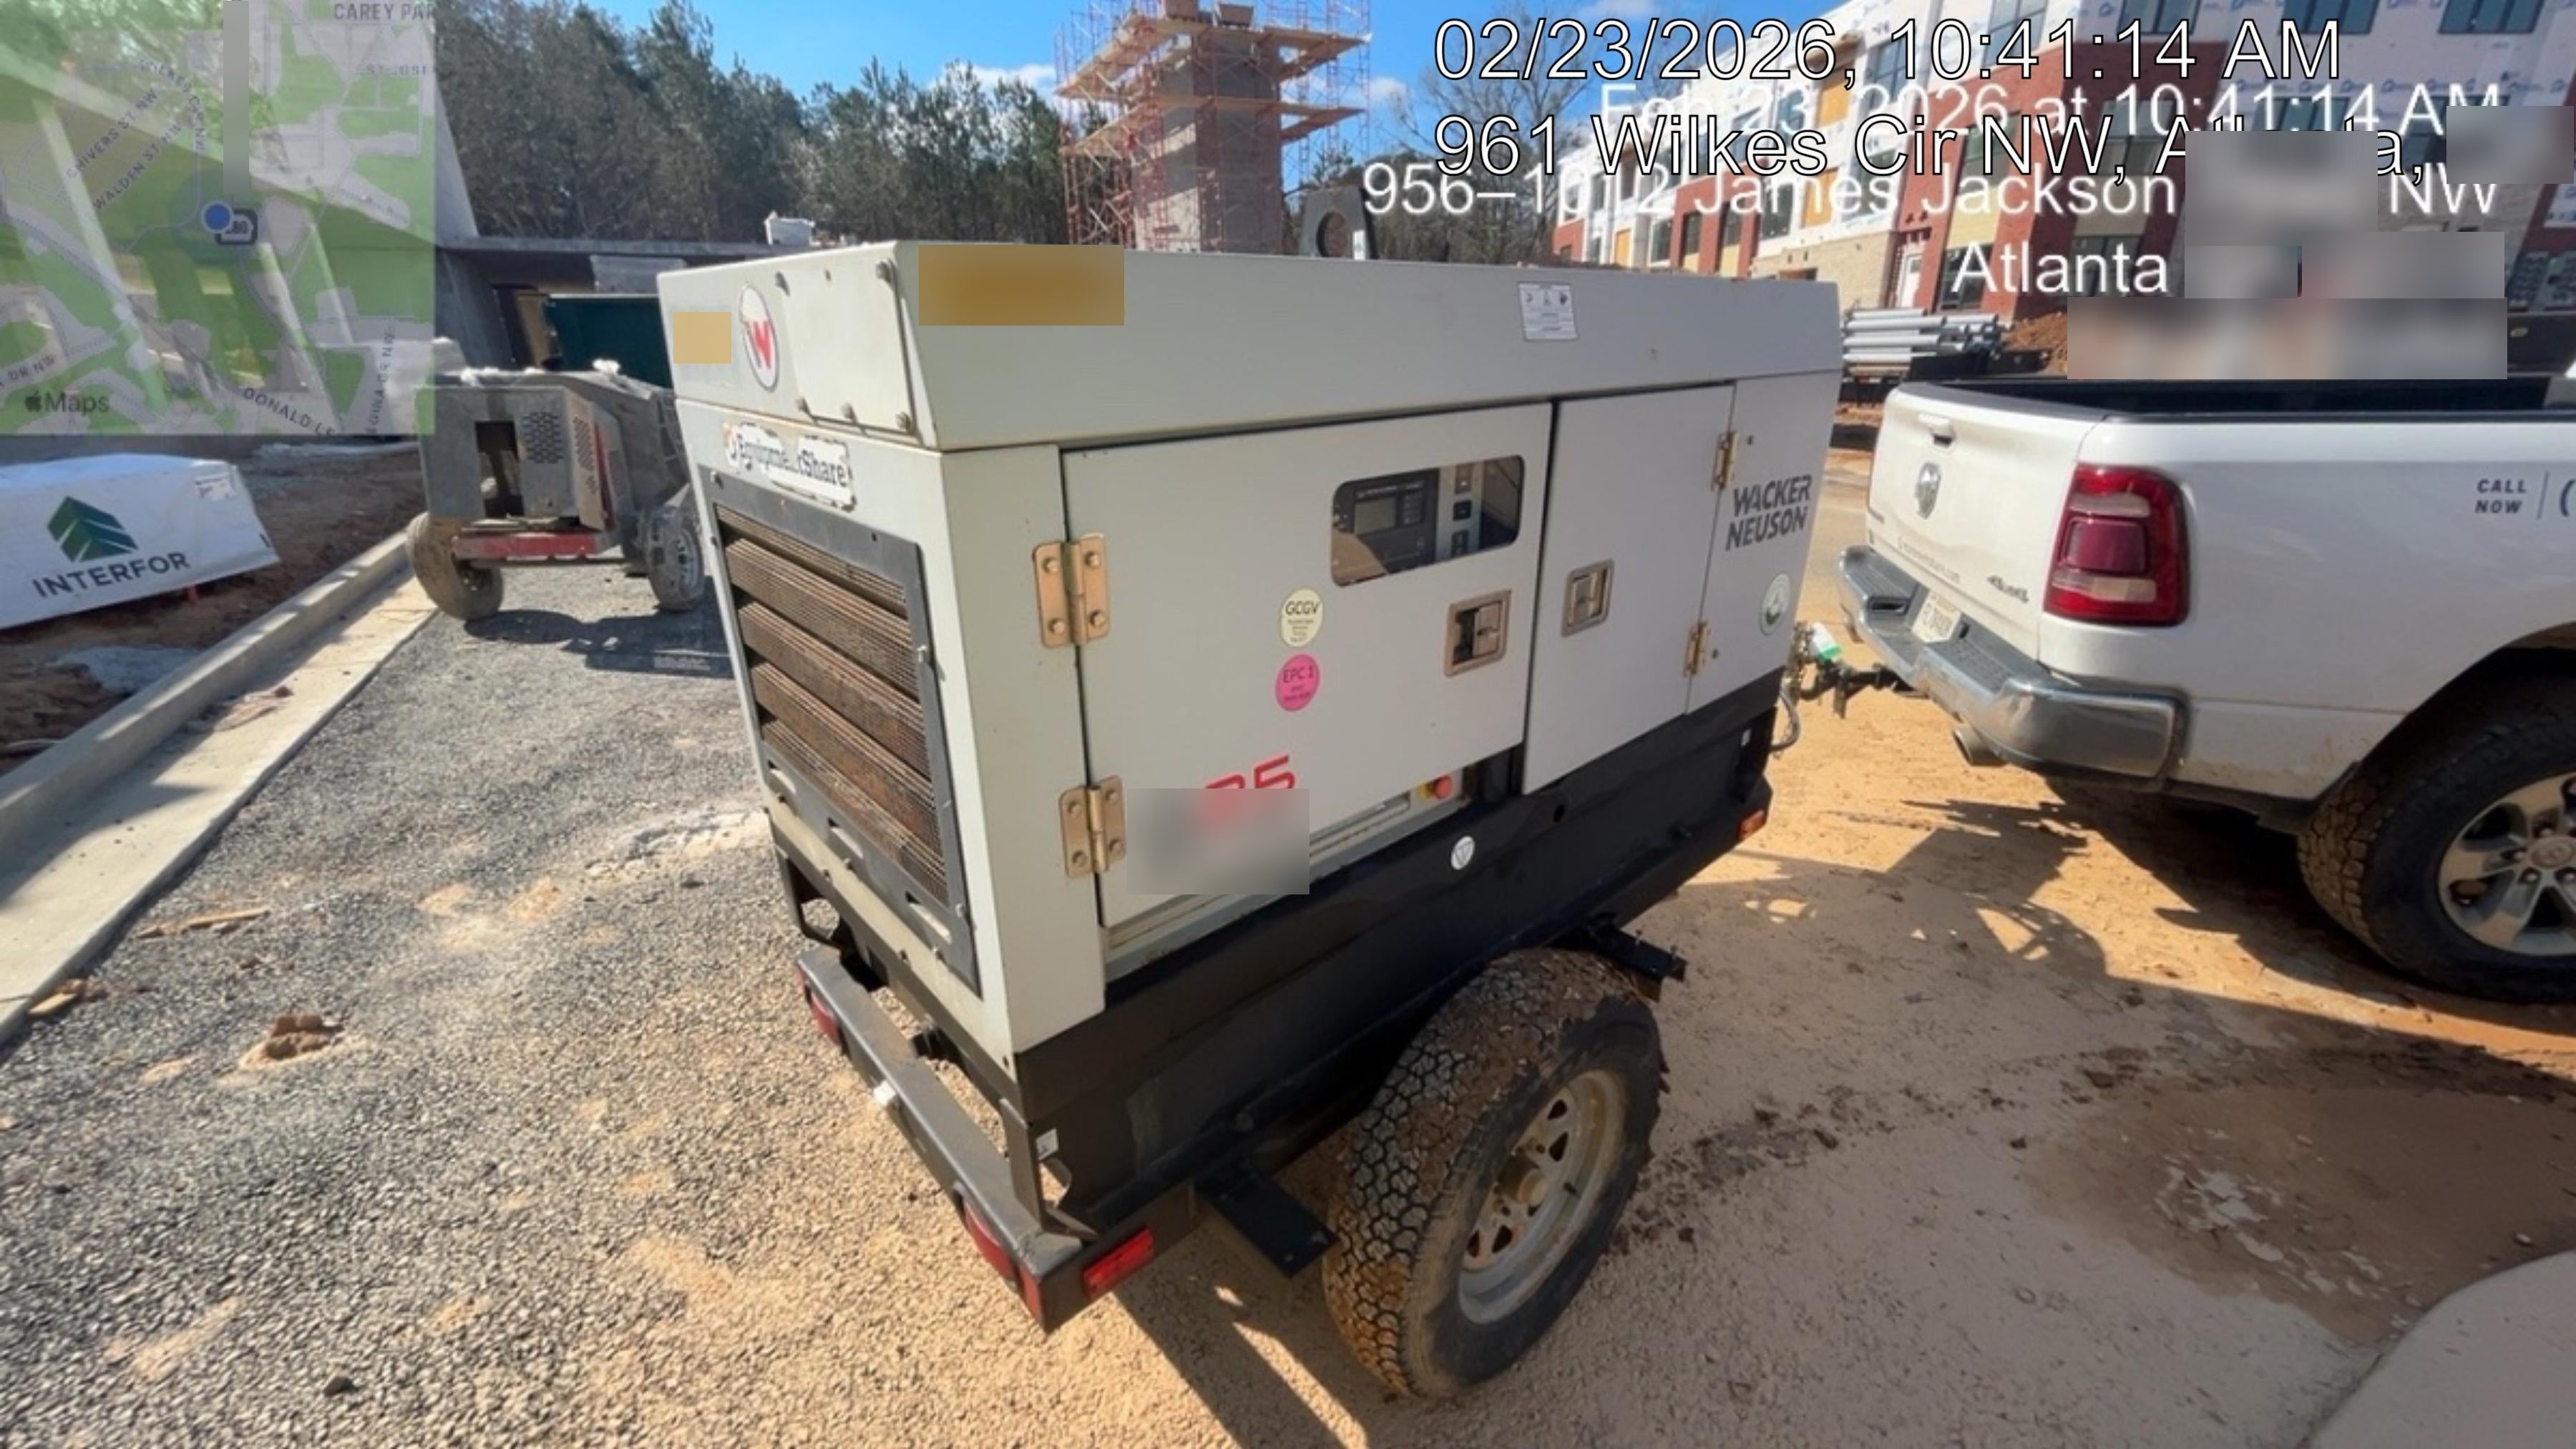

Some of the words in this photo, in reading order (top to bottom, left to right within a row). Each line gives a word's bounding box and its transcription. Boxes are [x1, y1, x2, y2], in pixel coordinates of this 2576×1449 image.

[1733, 474, 1813, 517] WACKER
[2474, 499, 2523, 514] NOW
[2477, 478, 2529, 494] CALL
[1725, 505, 1809, 552] NEUSON
[31, 552, 190, 598] INTERFOR
